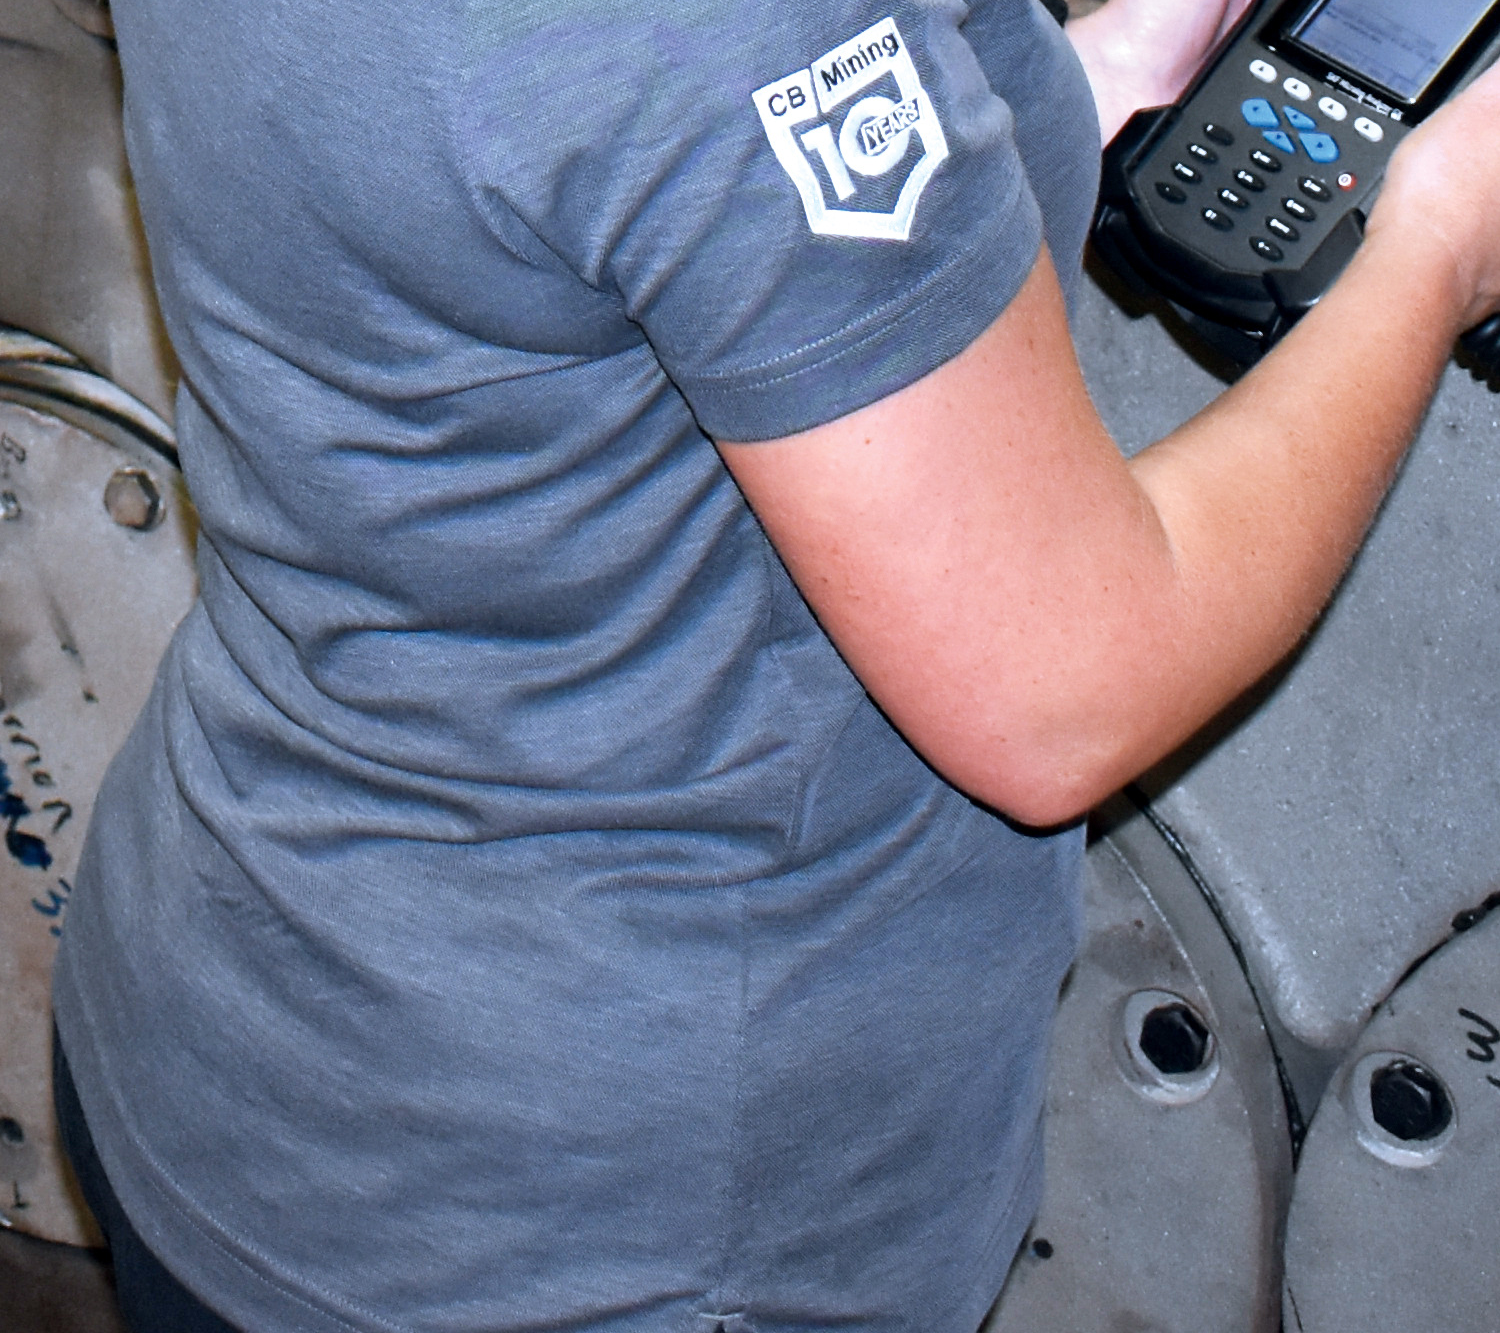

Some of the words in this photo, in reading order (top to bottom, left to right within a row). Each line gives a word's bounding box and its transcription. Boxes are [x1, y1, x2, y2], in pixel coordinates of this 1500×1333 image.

[767, 85, 806, 117] CB
[820, 31, 899, 93] Mining
[864, 97, 921, 152] YEARS
